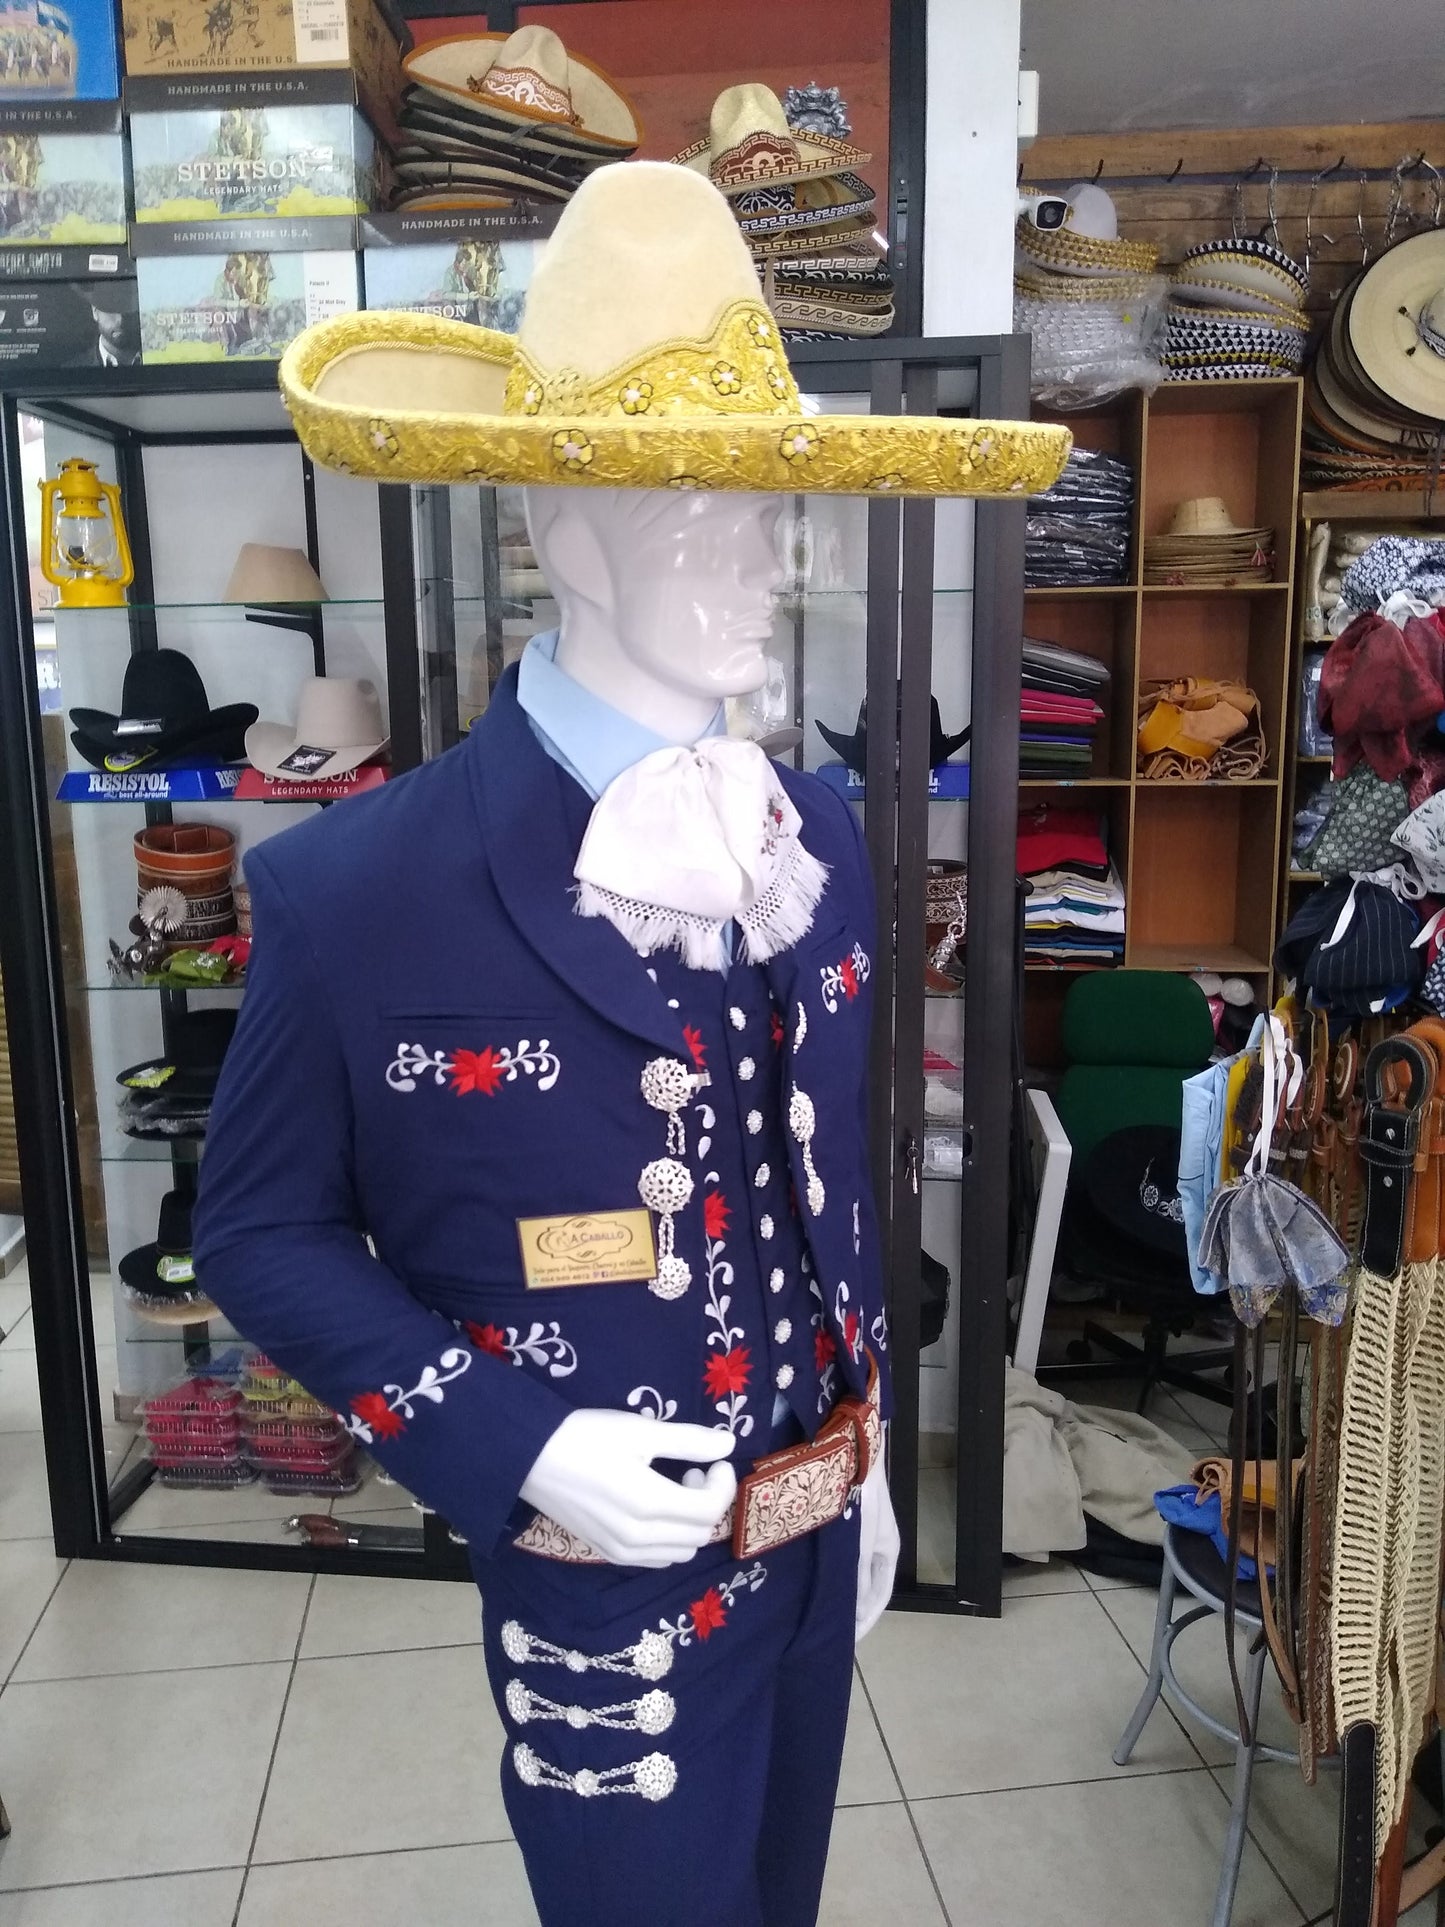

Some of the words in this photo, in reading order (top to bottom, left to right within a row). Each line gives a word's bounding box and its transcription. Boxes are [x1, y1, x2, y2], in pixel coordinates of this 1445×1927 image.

[167, 57, 231, 68] HANDMADE
[235, 56, 247, 65] IN
[250, 55, 272, 65] THE
[168, 84, 231, 95] HANDMADE
[235, 83, 247, 92] IN
[250, 82, 272, 92] THE
[275, 81, 309, 91] U.S.A.
[5, 111, 17, 120] IN
[20, 111, 41, 120] THE
[44, 110, 77, 120] U.S.A.
[178, 158, 307, 182] STETSON
[204, 185, 257, 195] LEGENDARY
[260, 183, 283, 193] HATS
[402, 218, 465, 230] HANDMADE
[469, 217, 481, 226] IN
[484, 216, 506, 226] THE
[509, 215, 543, 225] U.S.A.
[173, 230, 235, 242] HANDMADE
[240, 230, 251, 239] IN
[254, 229, 275, 239] THE
[279, 228, 313, 238] U.S.A.
[156, 311, 238, 326] STETSON
[88, 773, 169, 793] RESISTOL
[119, 791, 133, 799] best
[134, 791, 168, 799] all-around
[272, 786, 323, 796] LEGENDARY
[326, 786, 349, 794] HATS
